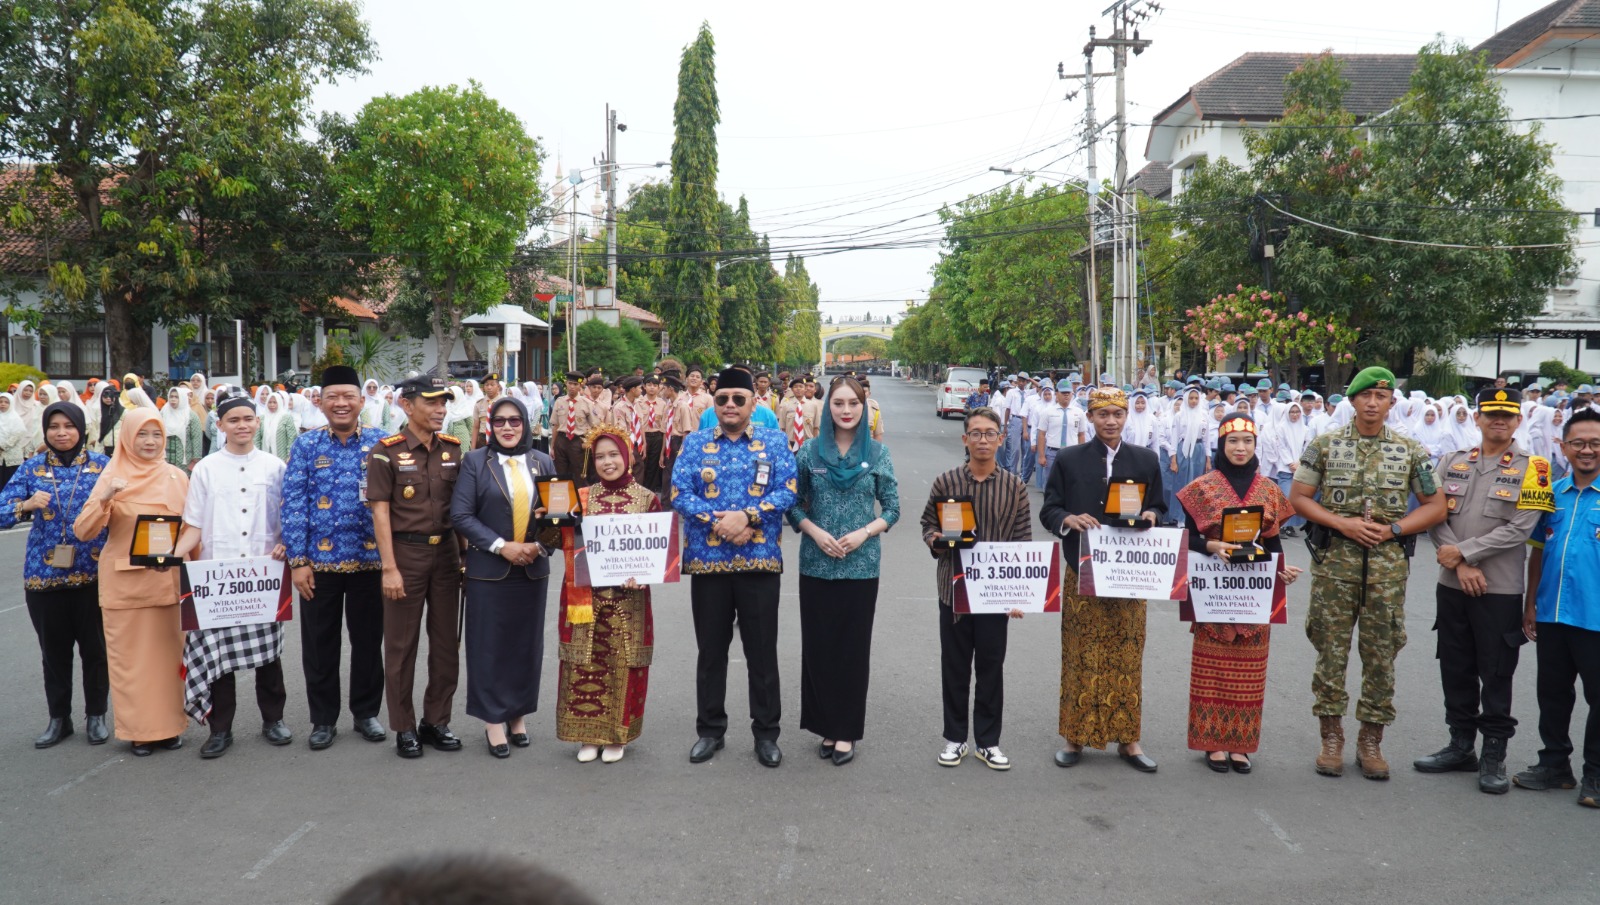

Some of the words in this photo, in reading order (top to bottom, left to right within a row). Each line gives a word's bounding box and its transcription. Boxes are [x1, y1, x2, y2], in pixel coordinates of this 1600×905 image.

[1495, 476, 1520, 485] POLRI
[594, 524, 643, 538] JUARA
[648, 522, 658, 534] II
[586, 540, 604, 554] Rp.
[608, 536, 667, 551] 4.500.000
[1100, 535, 1162, 547] HARAPAN
[1167, 538, 1170, 548] I
[971, 551, 1021, 565] JUARA
[1026, 551, 1042, 562] III
[1093, 549, 1111, 564] Rp.
[1115, 550, 1176, 565] 2.000.000
[966, 566, 984, 581] Rp.
[988, 566, 1048, 579] 3.500.000
[1111, 568, 1157, 576] WIRAUSAHA
[1195, 563, 1255, 572] HARAPAN
[1259, 563, 1267, 571] II
[205, 567, 258, 584] JUARA
[264, 566, 267, 576] I
[194, 585, 213, 599] Rp.
[218, 578, 280, 595] 7.500.000
[1192, 576, 1210, 590] Rp.
[1213, 576, 1272, 589] 1.500.000
[214, 597, 262, 607] WIRAUSAHA
[209, 605, 234, 614] MUDA
